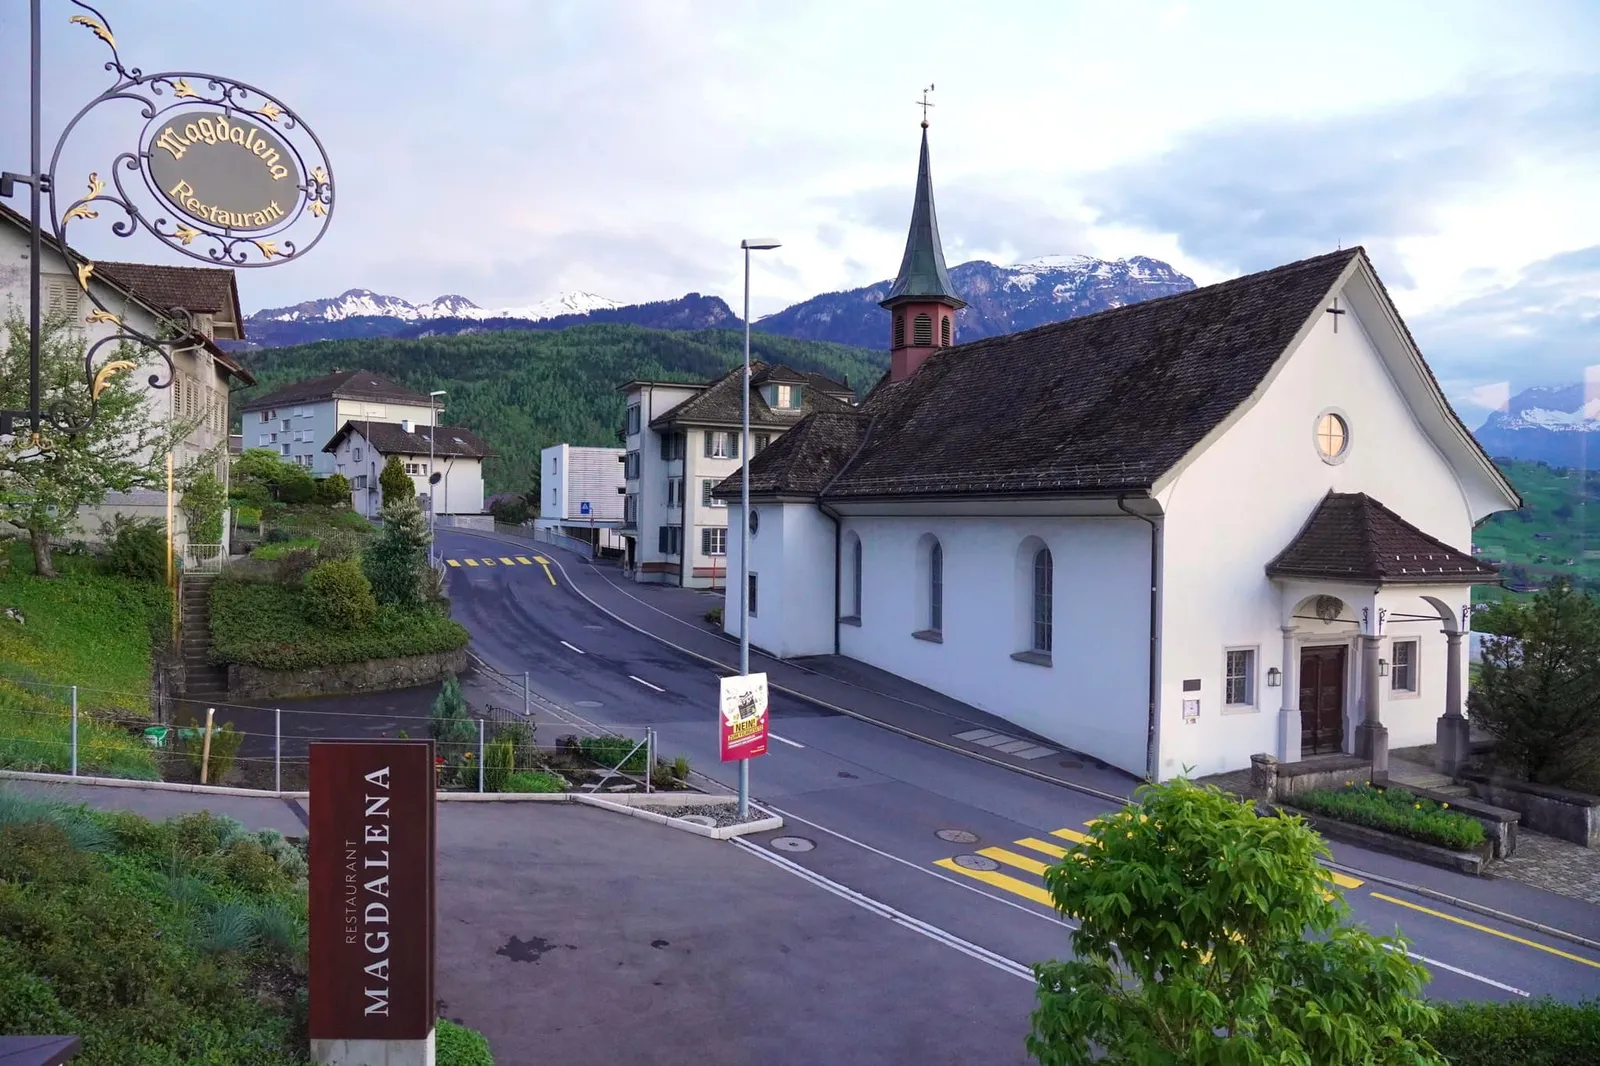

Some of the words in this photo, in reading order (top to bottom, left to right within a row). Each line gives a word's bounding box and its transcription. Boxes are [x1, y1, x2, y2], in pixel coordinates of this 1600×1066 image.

[157, 116, 288, 180] Magdalena
[168, 179, 284, 227] Restaurant
[735, 719, 756, 732] NEIN!
[345, 839, 357, 944] RESTAURANT
[364, 766, 390, 1017] MAGDALENA
